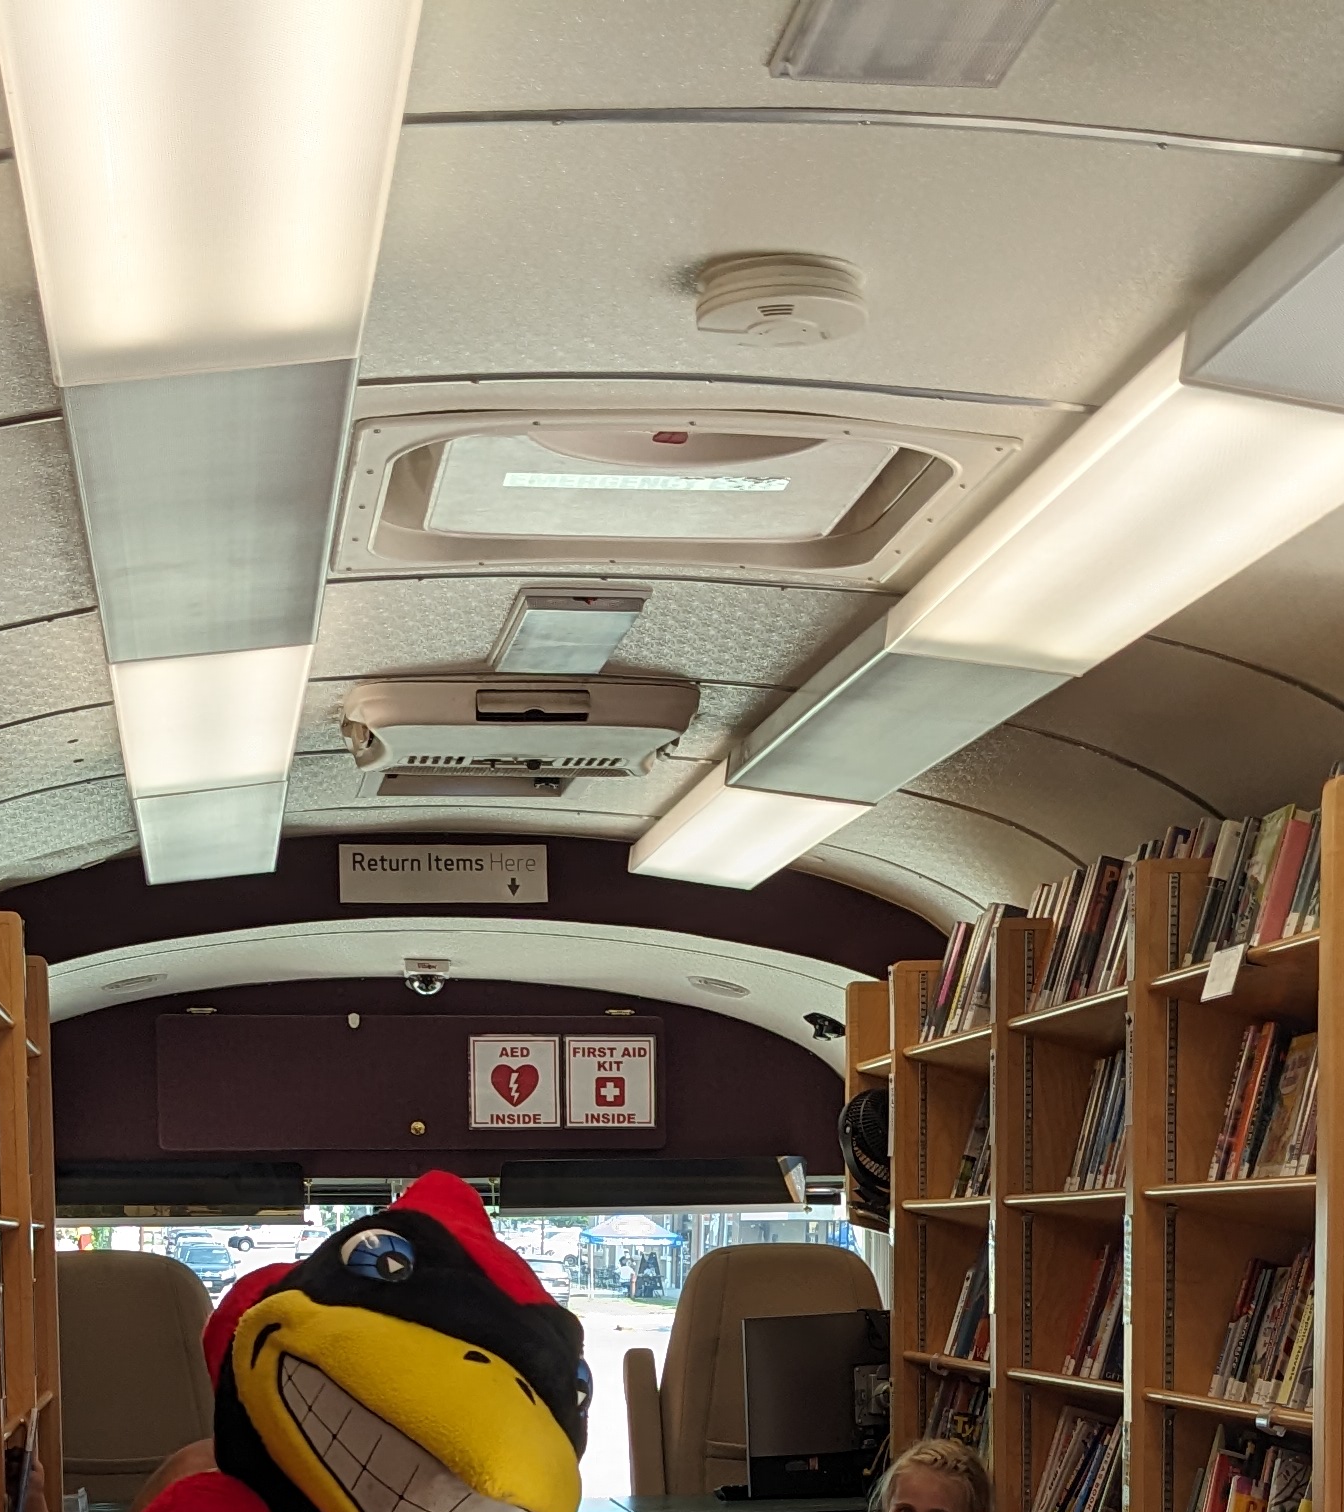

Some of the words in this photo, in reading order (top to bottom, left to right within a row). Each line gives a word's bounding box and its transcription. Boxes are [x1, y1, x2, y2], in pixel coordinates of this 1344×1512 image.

[352, 853, 421, 872] Return
[428, 853, 484, 872] Items
[490, 853, 537, 872] Here
[498, 1047, 530, 1058] AED
[572, 1047, 617, 1058] FIRST
[621, 1047, 648, 1058] AID
[597, 1061, 623, 1072] KIT
[490, 1114, 542, 1125] INSIDE
[584, 1113, 636, 1125] INSIDE
